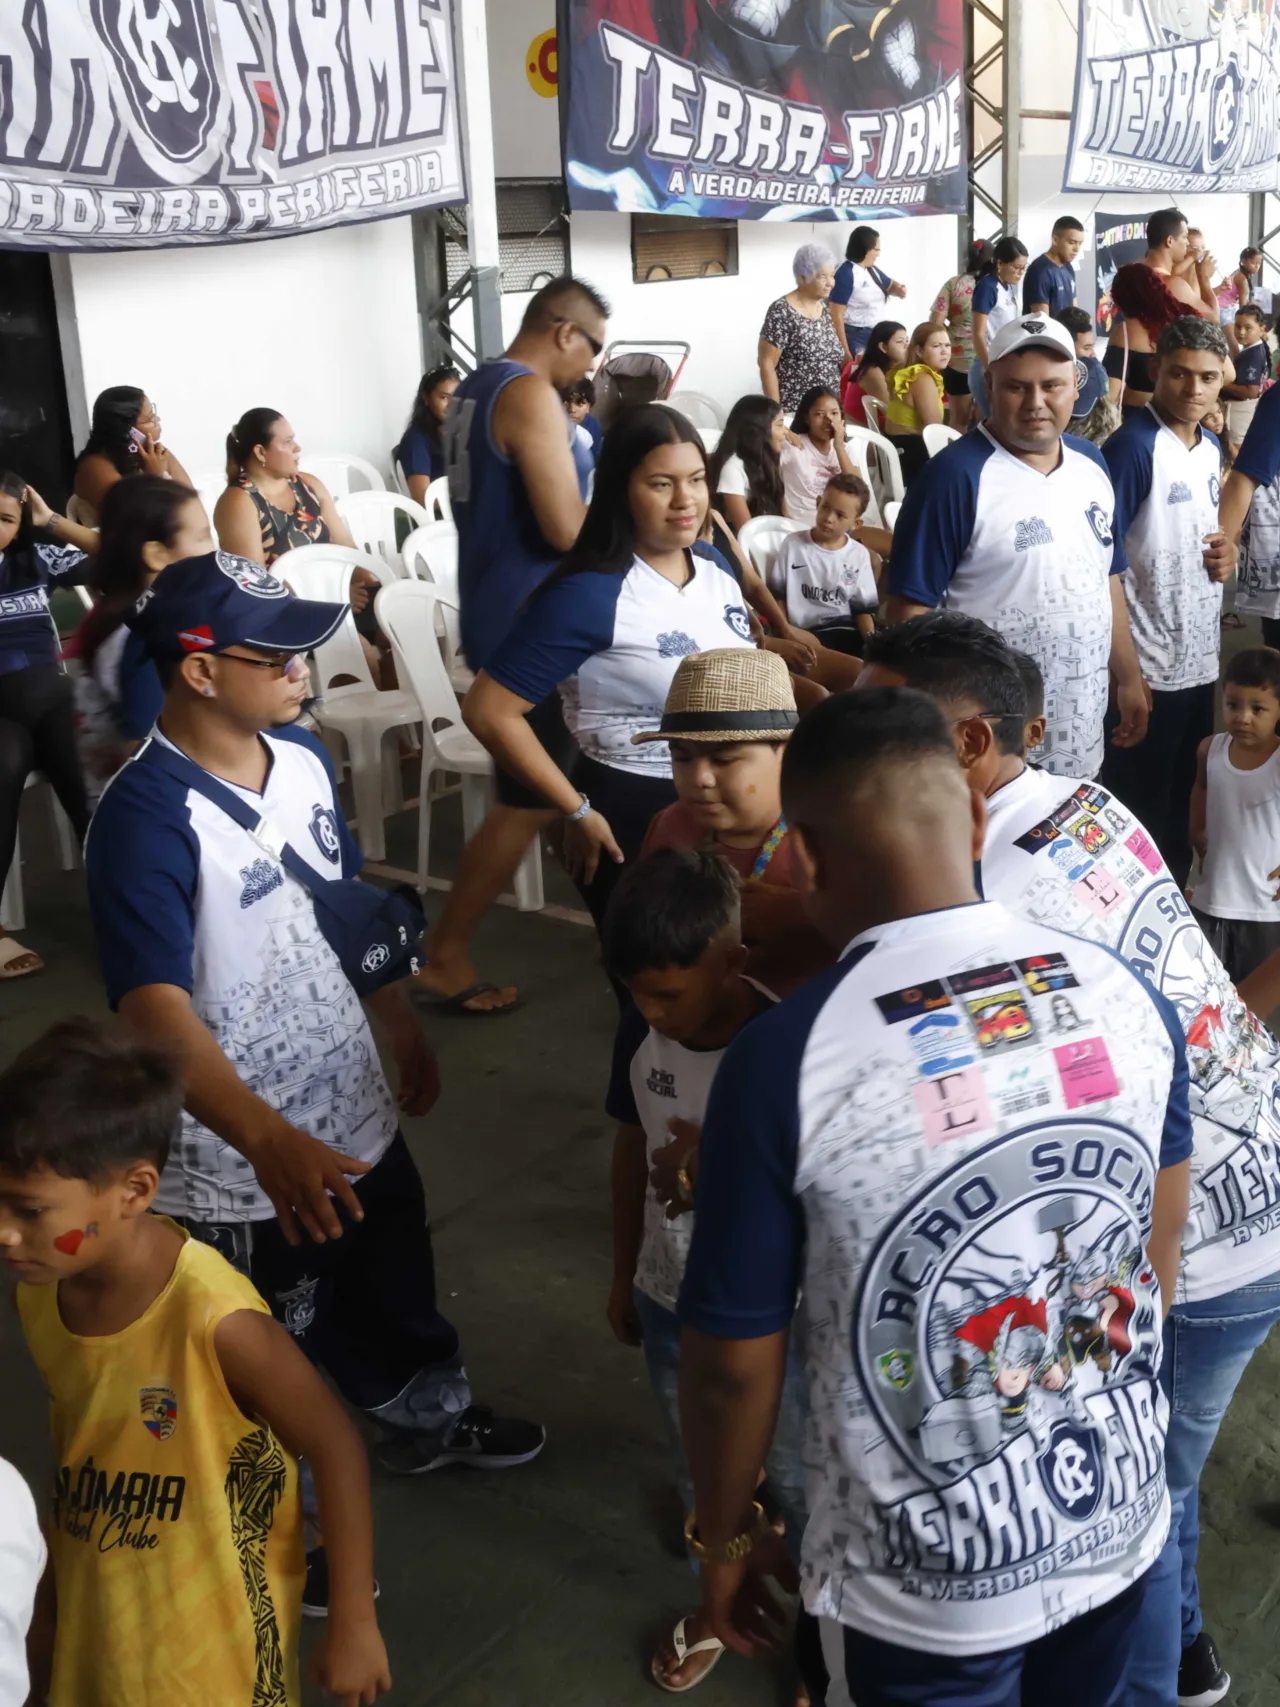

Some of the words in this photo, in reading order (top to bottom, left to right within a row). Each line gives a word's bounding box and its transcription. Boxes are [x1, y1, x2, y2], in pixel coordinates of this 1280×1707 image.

[227, 150, 446, 234] PERIFERIA
[667, 170, 687, 194] A
[690, 171, 833, 206] VERDADEIRA
[835, 184, 927, 206] PERIFERIA
[1108, 160, 1214, 192] VERDADEIRA
[876, 1176, 999, 1326] AÇÃO
[1232, 1227, 1252, 1248] A
[97, 1511, 160, 1553] Clube
[926, 1513, 1118, 1602] VERDADEIRA
